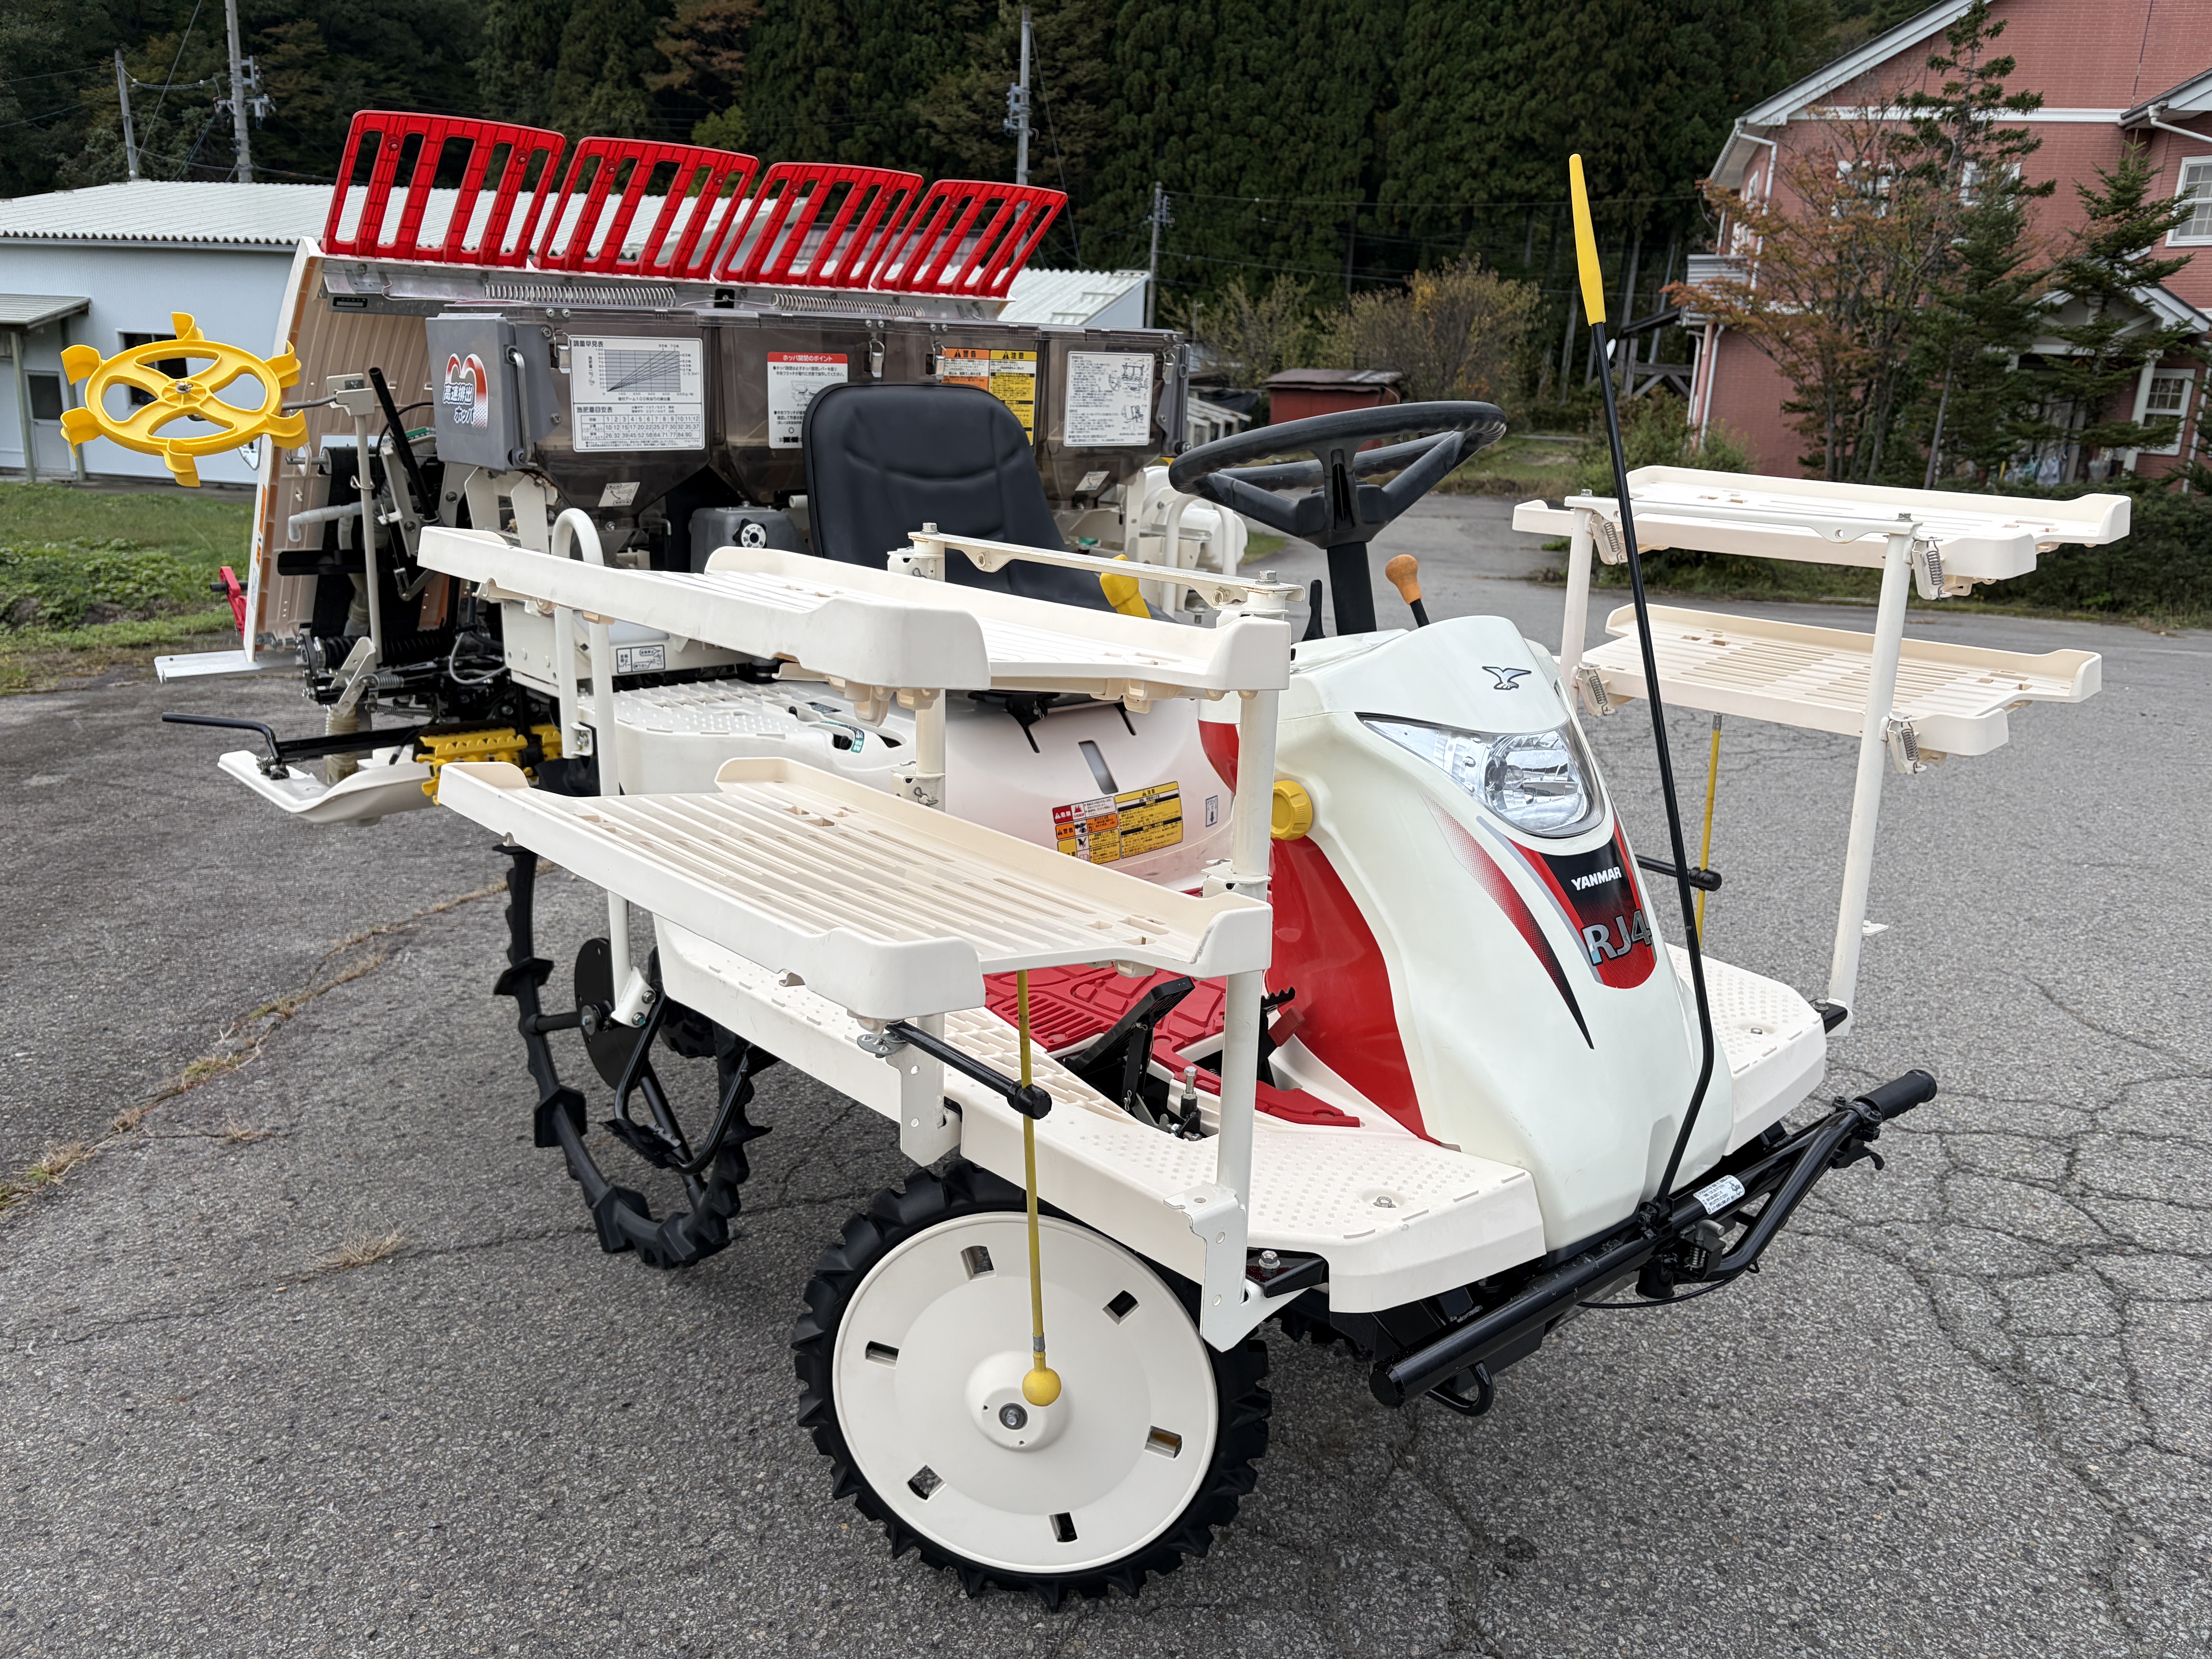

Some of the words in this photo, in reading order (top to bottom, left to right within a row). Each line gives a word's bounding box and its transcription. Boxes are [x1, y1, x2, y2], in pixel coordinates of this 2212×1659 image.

[444, 383, 473, 404] 高速排出
[454, 407, 475, 424] ホッパ
[1571, 867, 1622, 891] YANMAR
[1581, 909, 1652, 965] RJ4
